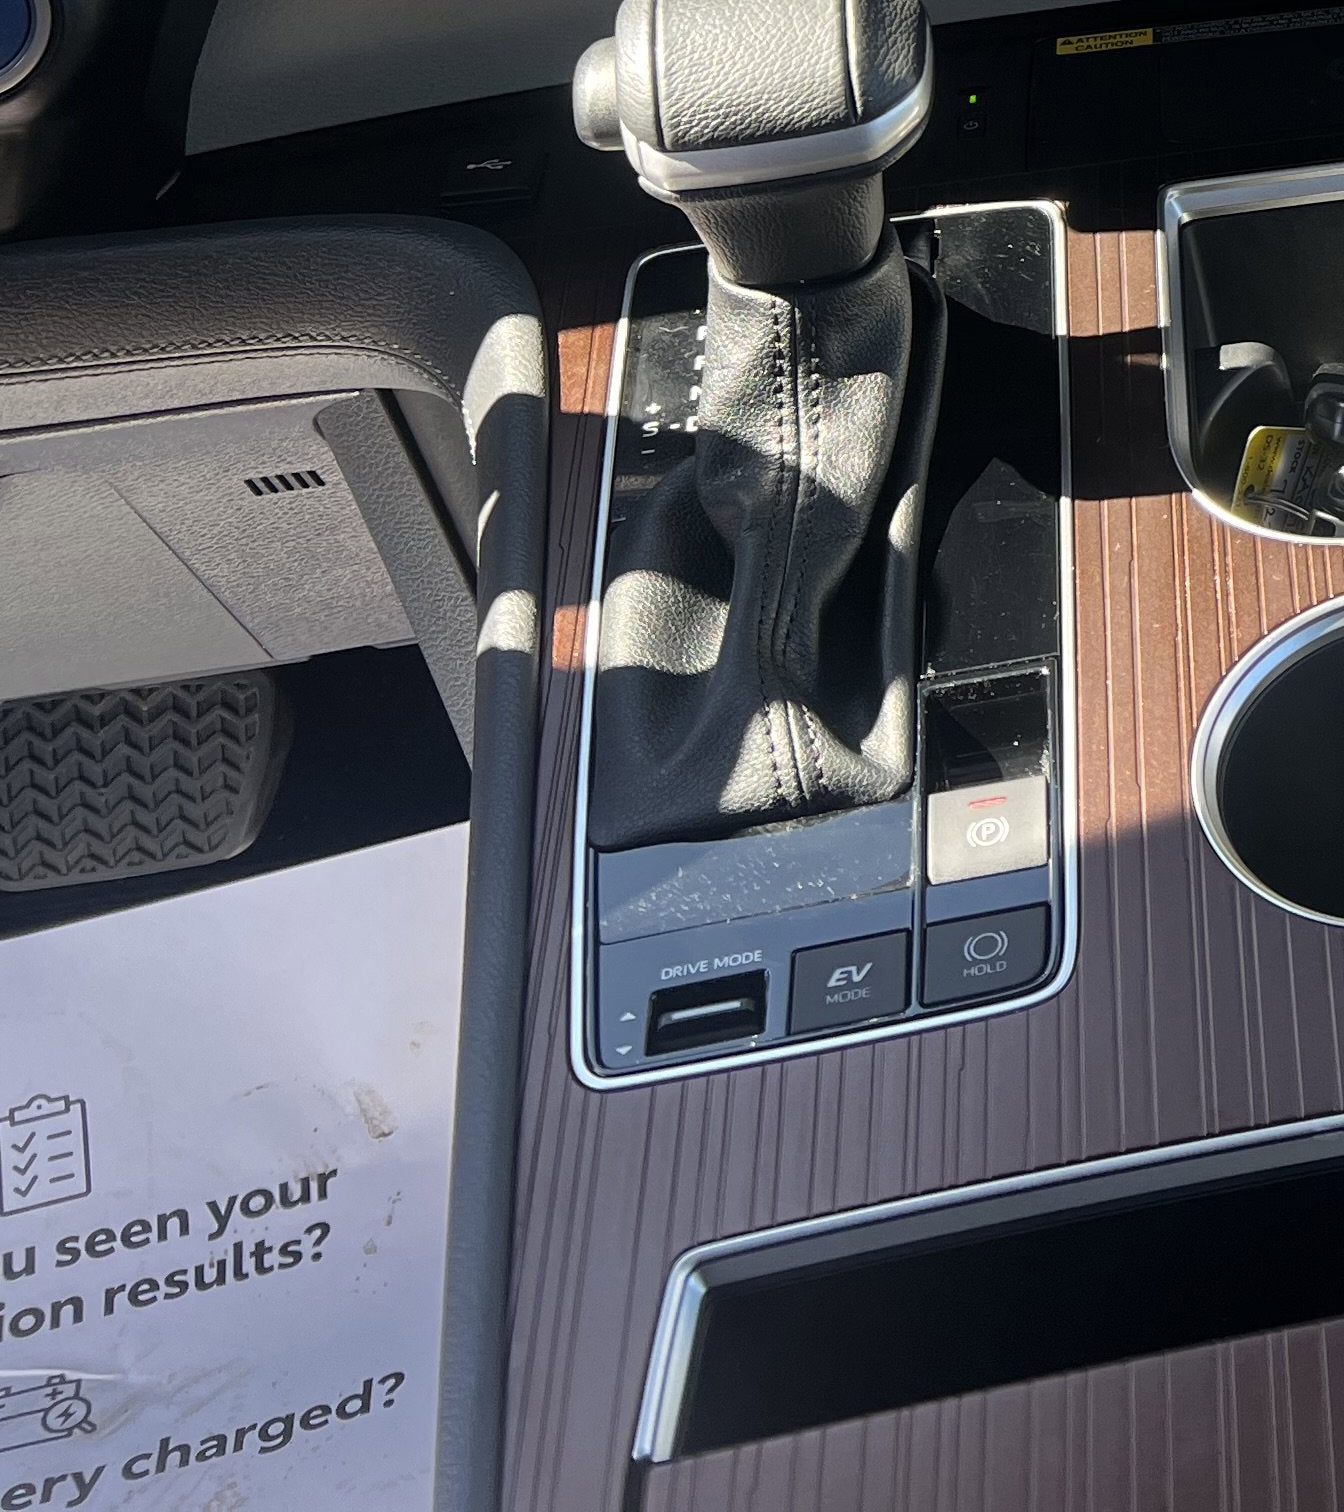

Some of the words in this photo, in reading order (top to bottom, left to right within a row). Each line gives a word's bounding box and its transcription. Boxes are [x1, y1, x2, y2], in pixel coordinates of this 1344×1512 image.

[1074, 30, 1148, 45] ATTENTION
[1074, 38, 1135, 52] CAUTION
[660, 957, 709, 981] DRIVE
[713, 950, 764, 971] MODE
[826, 961, 874, 989] EV
[962, 959, 1008, 978] HOLD
[825, 986, 872, 1006] MODE
[54, 1206, 190, 1269] seen
[205, 1168, 338, 1240] your
[102, 1222, 331, 1317] results?
[121, 1372, 406, 1482] charged?
